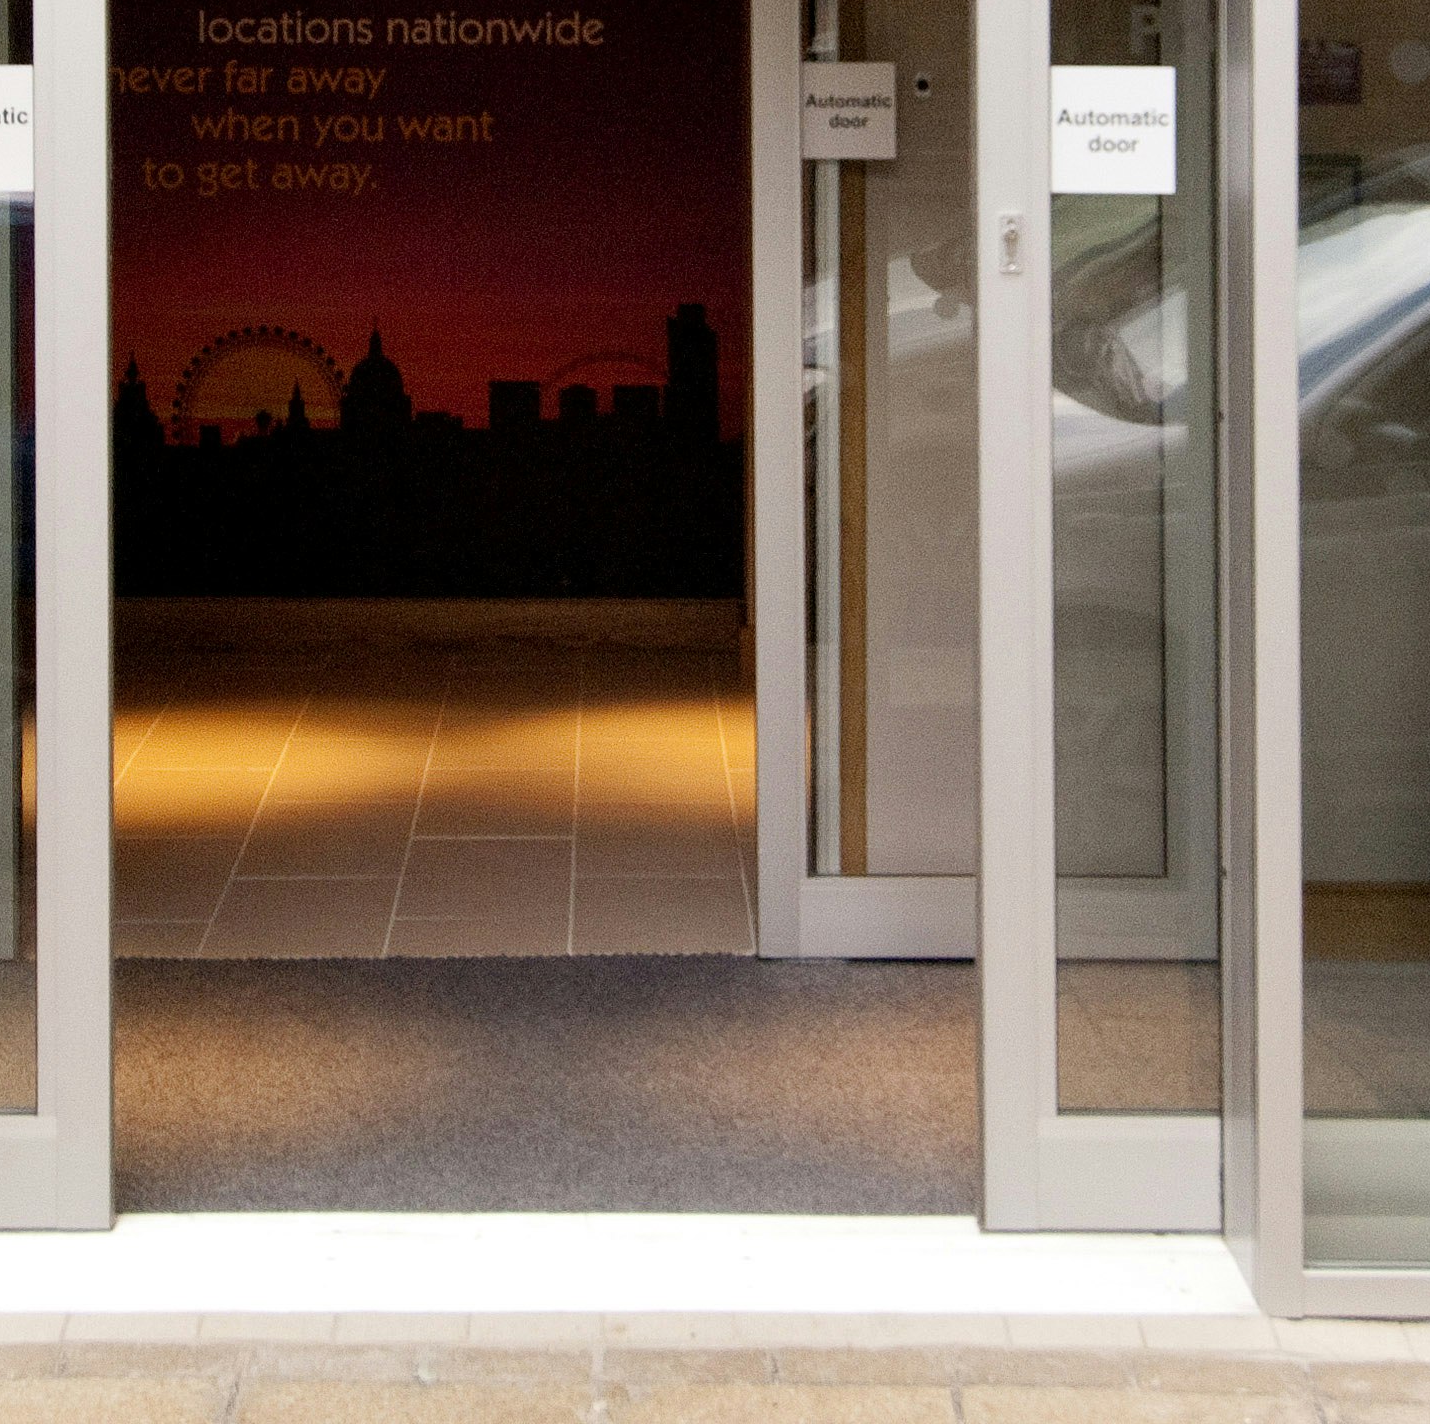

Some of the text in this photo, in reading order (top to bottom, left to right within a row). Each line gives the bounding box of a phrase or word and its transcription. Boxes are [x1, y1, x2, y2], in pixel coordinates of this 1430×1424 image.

[198, 9, 604, 46] locations nationwide
[224, 58, 275, 94] far
[286, 66, 387, 100] away
[805, 93, 892, 110] Automatic
[191, 106, 495, 148] when you want
[829, 114, 868, 129] door
[1057, 108, 1169, 127] Automatic
[1087, 134, 1139, 153] door
[141, 157, 378, 198] to get away.
